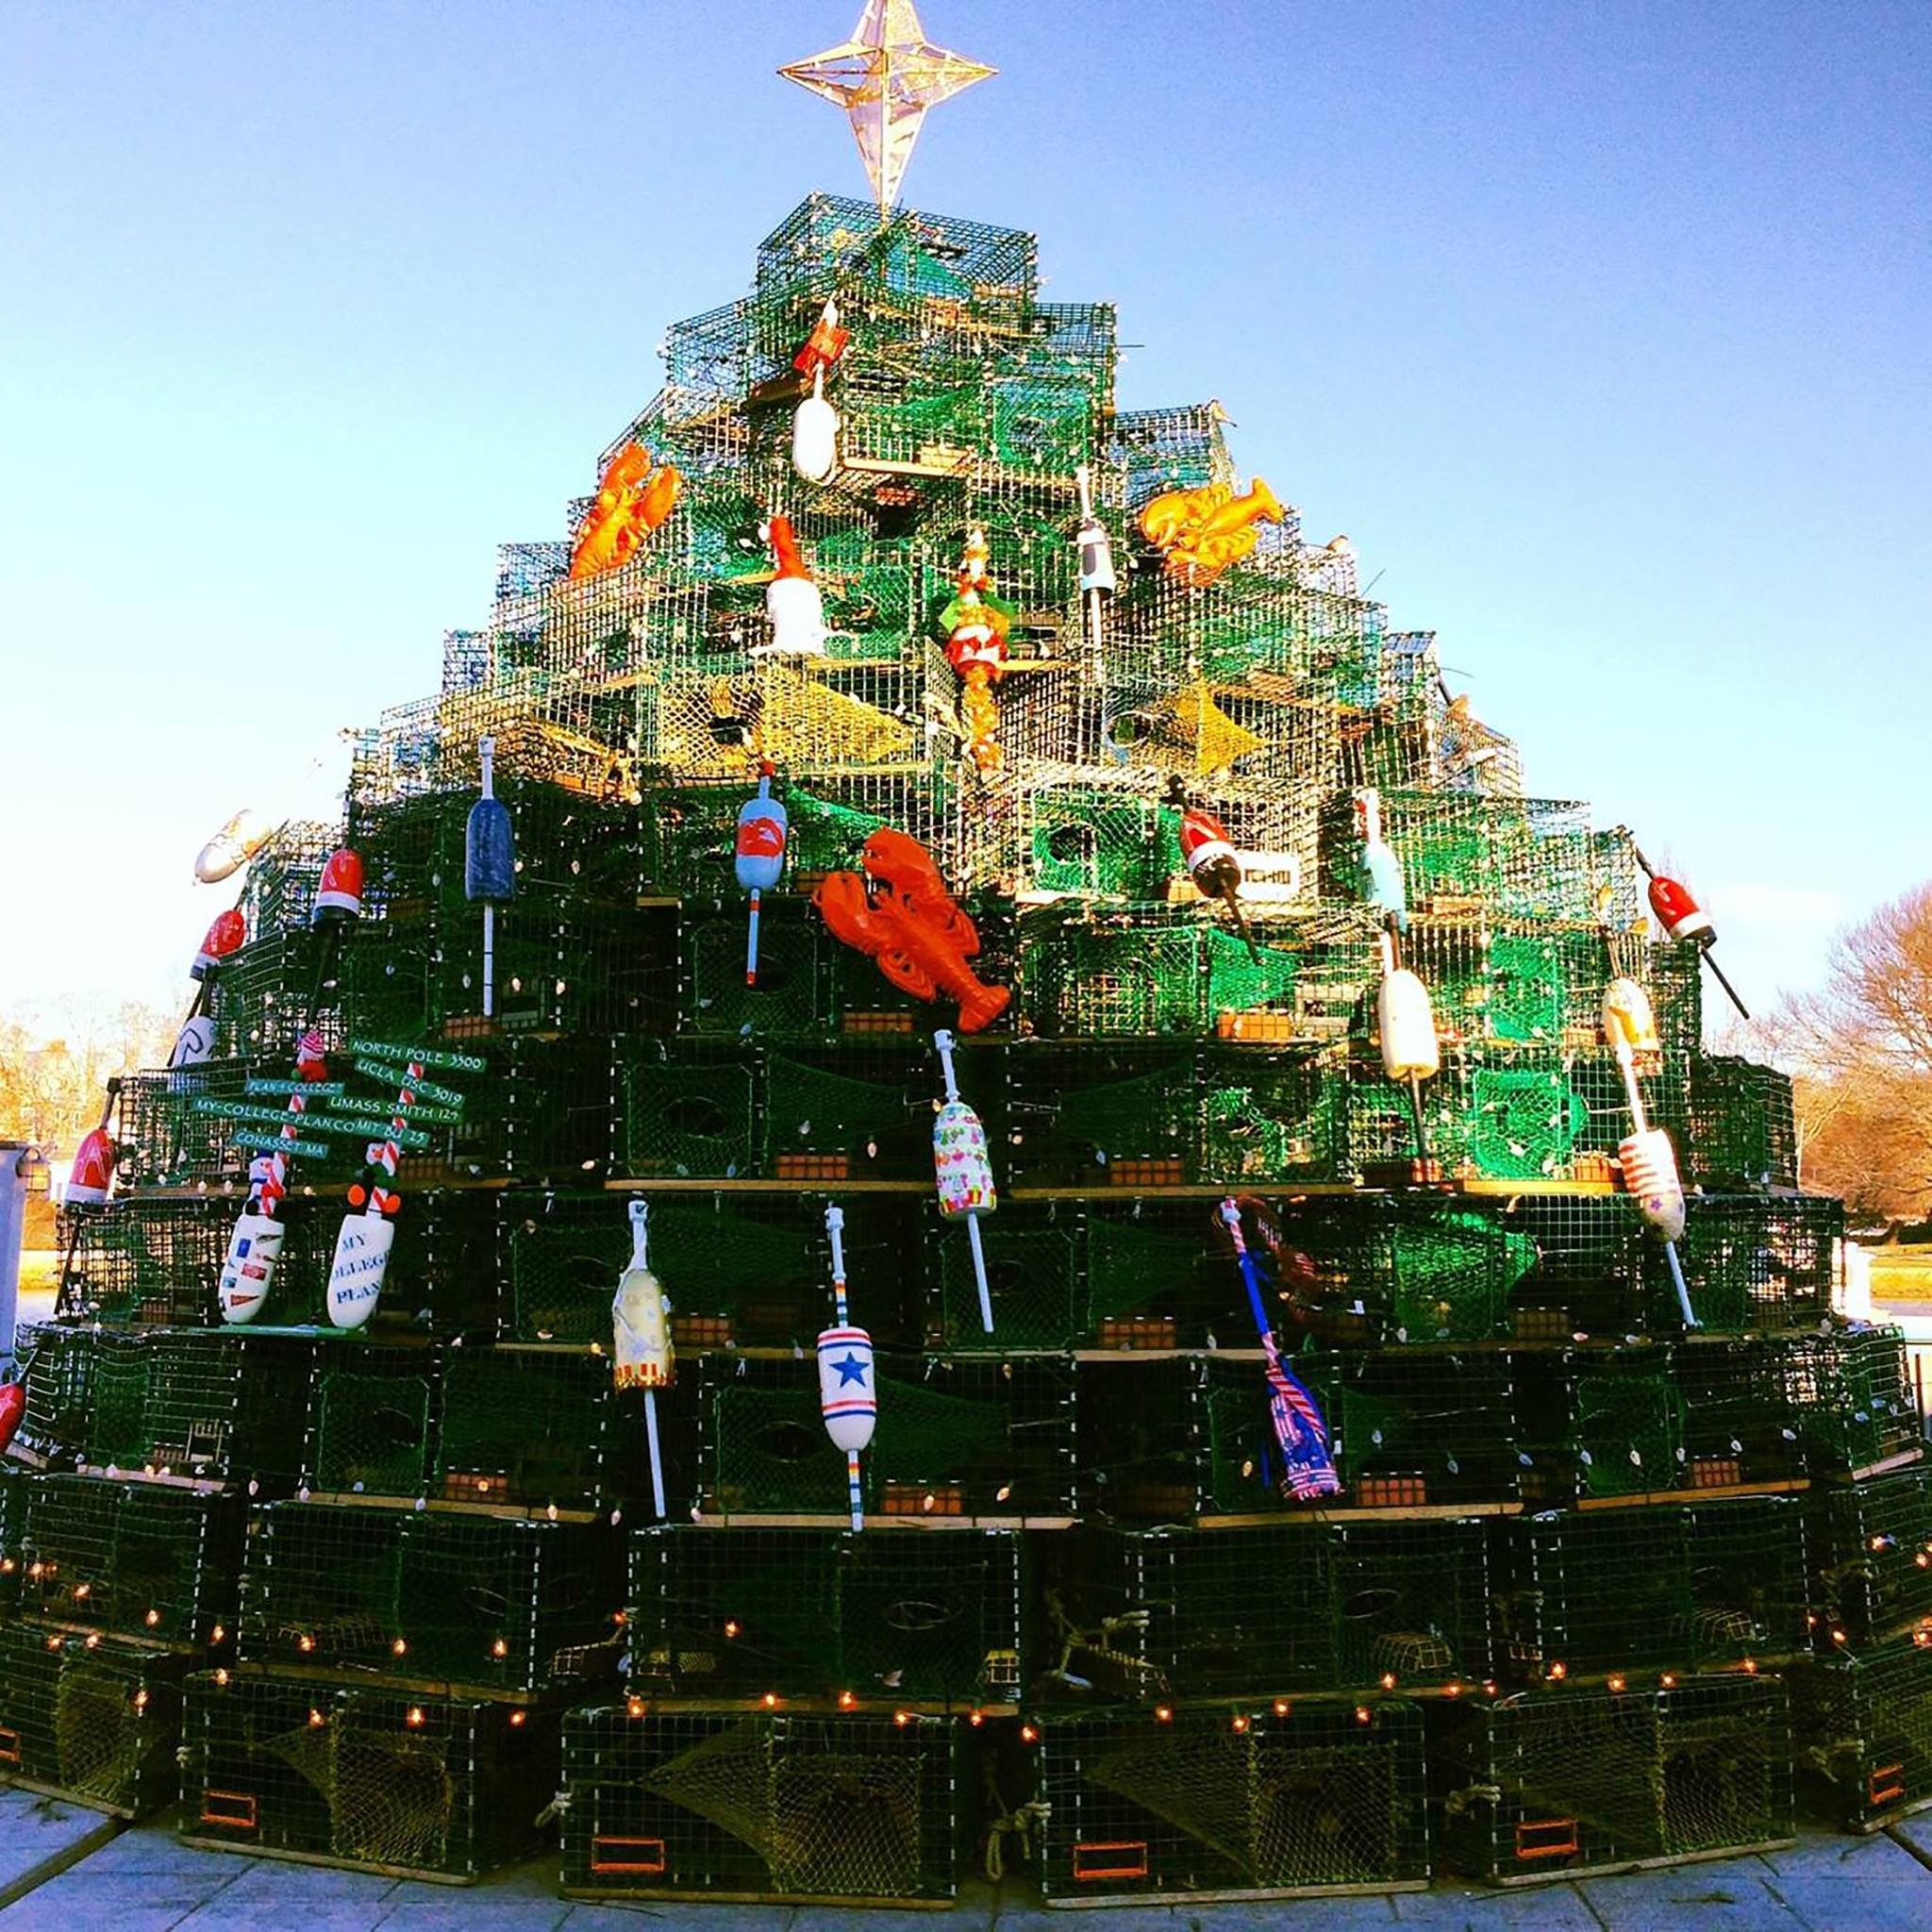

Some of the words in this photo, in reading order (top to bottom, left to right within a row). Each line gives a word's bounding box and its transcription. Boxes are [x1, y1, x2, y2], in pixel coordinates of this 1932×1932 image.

[353, 1041, 401, 1058] NORTH
[406, 1048, 443, 1064] POLE
[358, 1058, 394, 1081] UCLA
[401, 1074, 428, 1092] USC
[330, 1096, 381, 1112] UMASS
[386, 1102, 434, 1118] SMITH
[356, 1119, 379, 1132] MIT
[236, 1132, 300, 1152] COHASSET
[306, 1143, 325, 1156] MA
